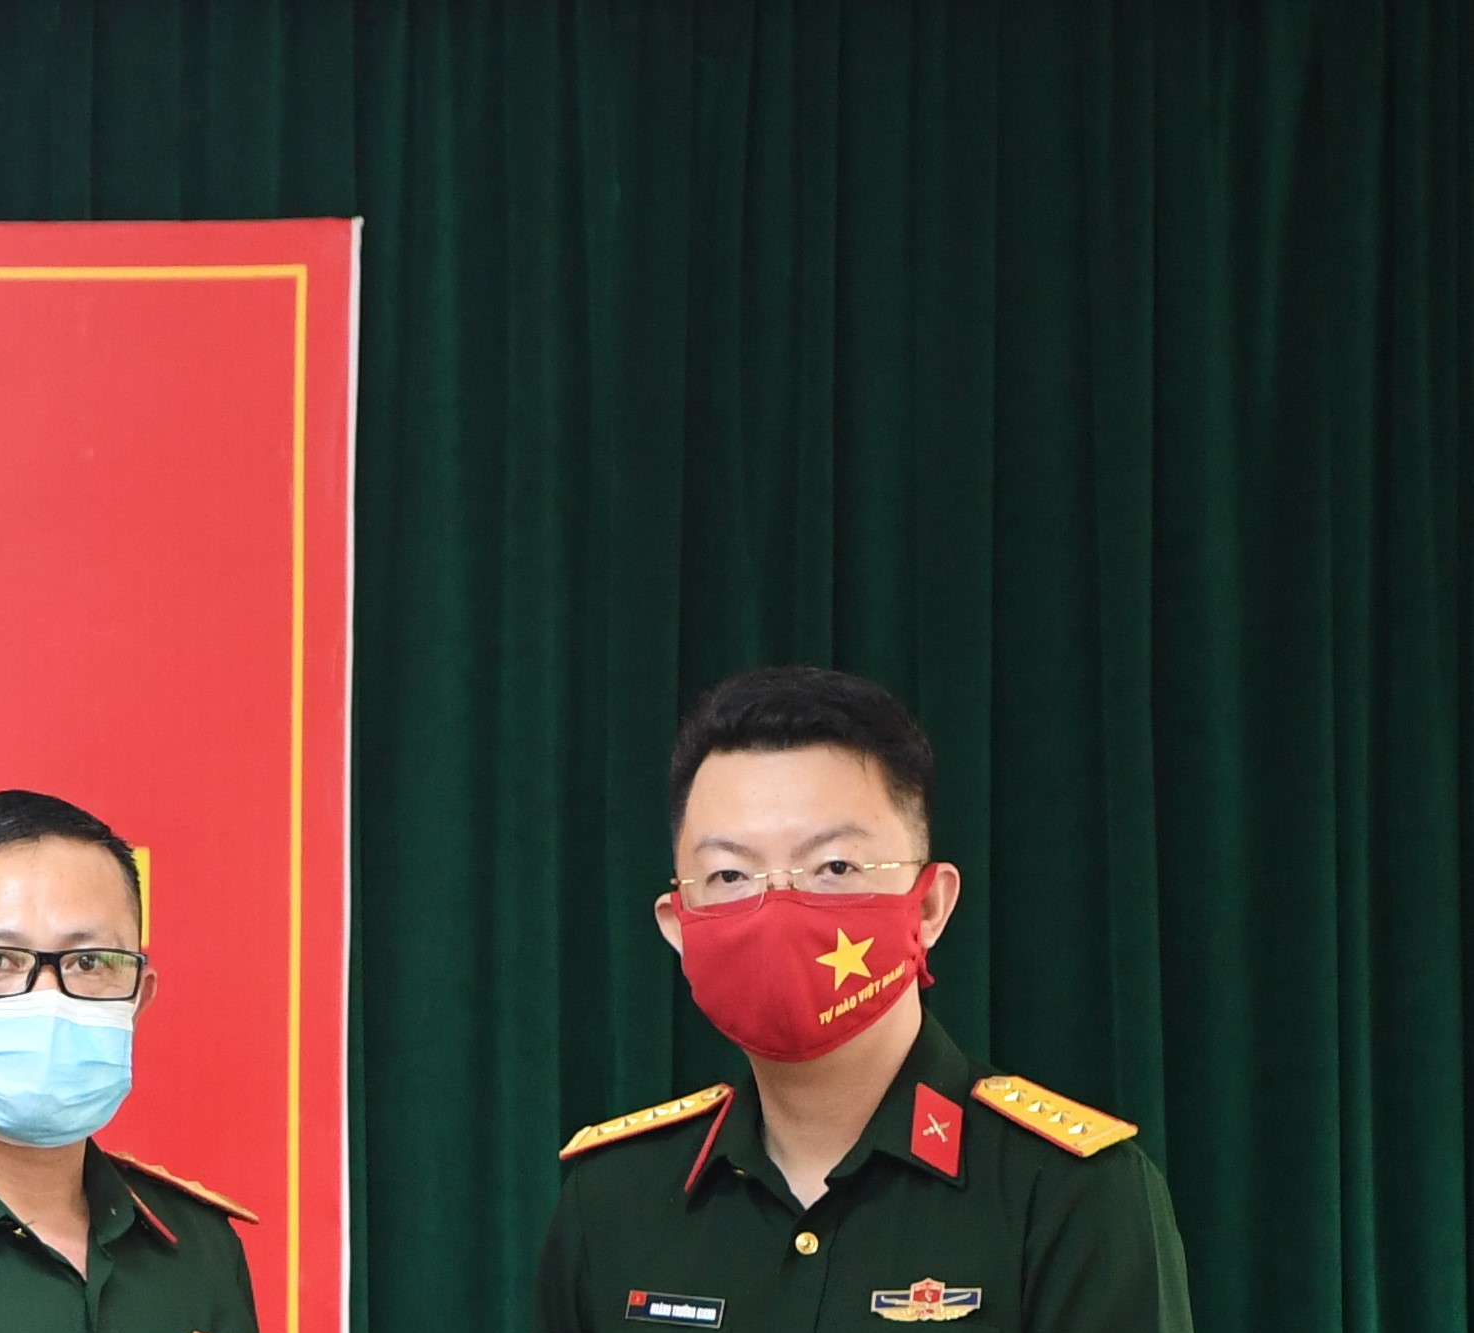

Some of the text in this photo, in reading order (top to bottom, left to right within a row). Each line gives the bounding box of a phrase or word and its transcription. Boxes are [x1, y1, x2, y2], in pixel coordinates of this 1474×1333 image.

[818, 1005, 834, 1025] TỰ
[835, 995, 857, 1017] HÀO
[857, 979, 881, 1003] VIỆT
